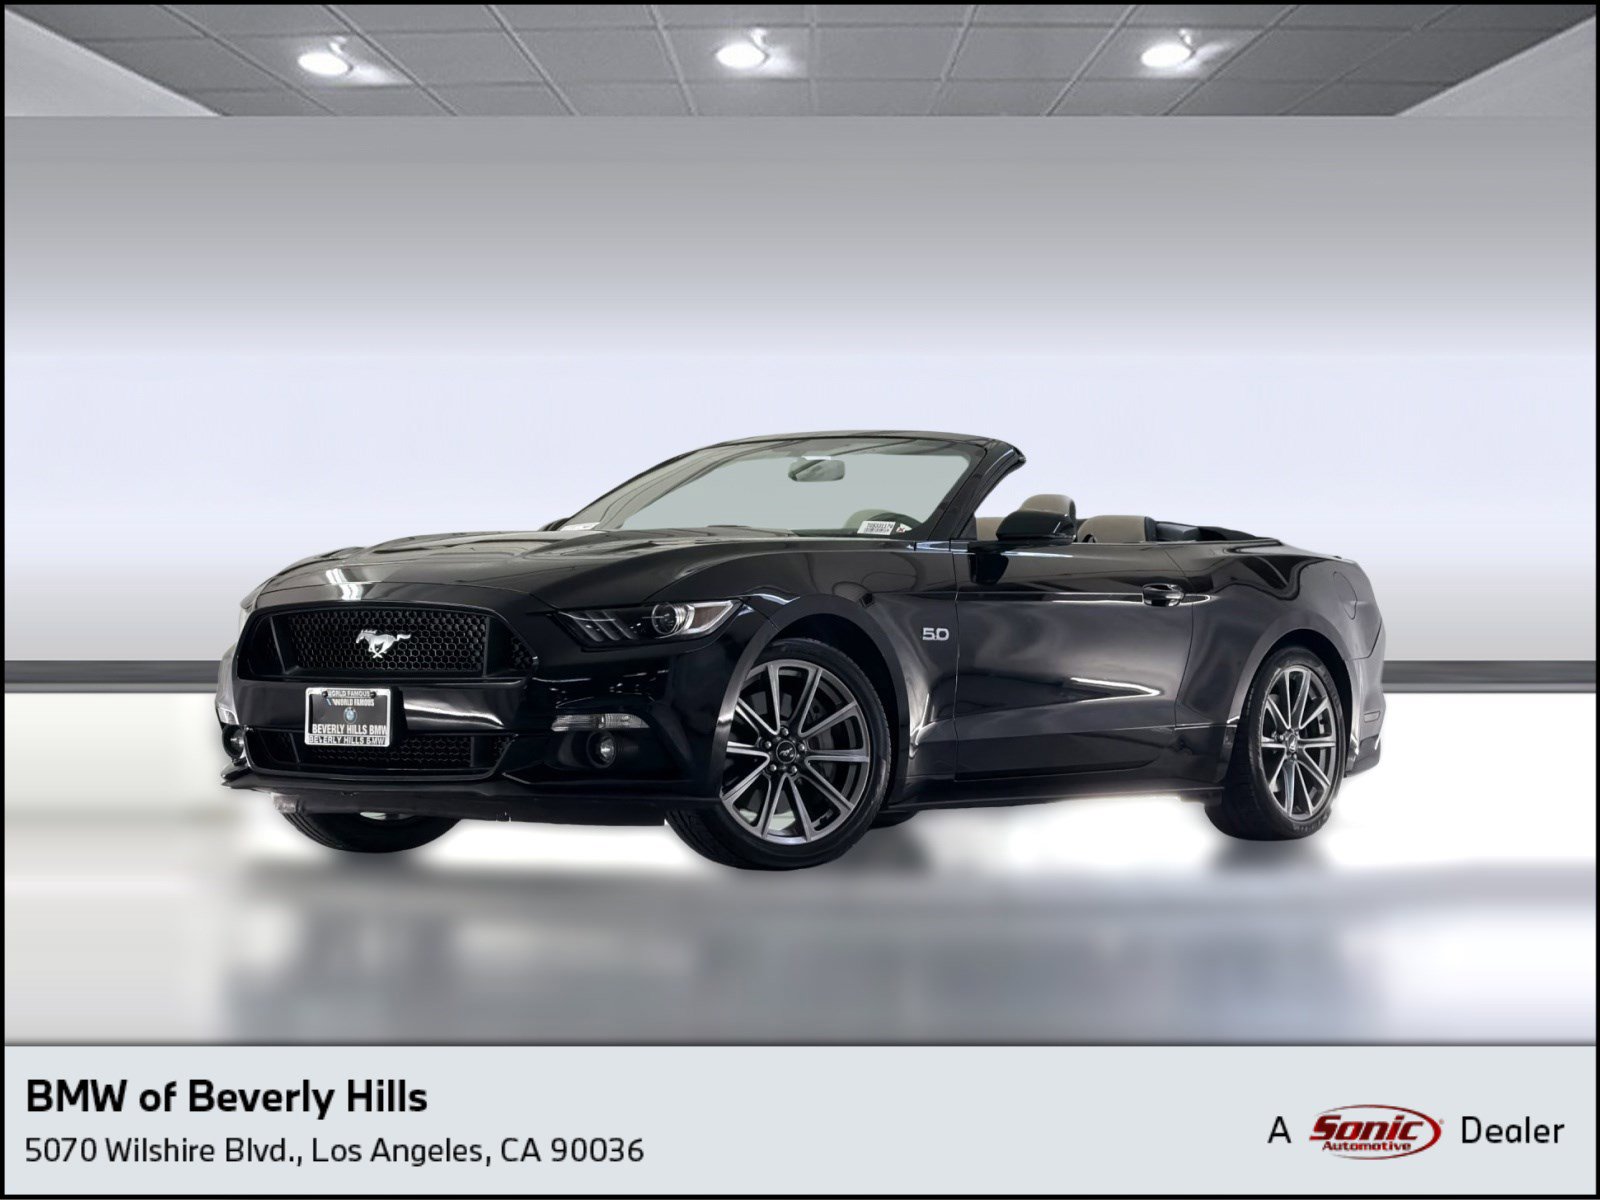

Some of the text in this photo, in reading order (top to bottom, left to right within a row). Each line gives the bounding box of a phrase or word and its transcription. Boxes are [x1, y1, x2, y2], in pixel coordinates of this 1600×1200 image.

[332, 698, 375, 707] WORLD FAMOUS
[312, 723, 388, 736] BEVERLY HILLS BMW
[309, 735, 386, 745] BEVERLY HILLS BMW
